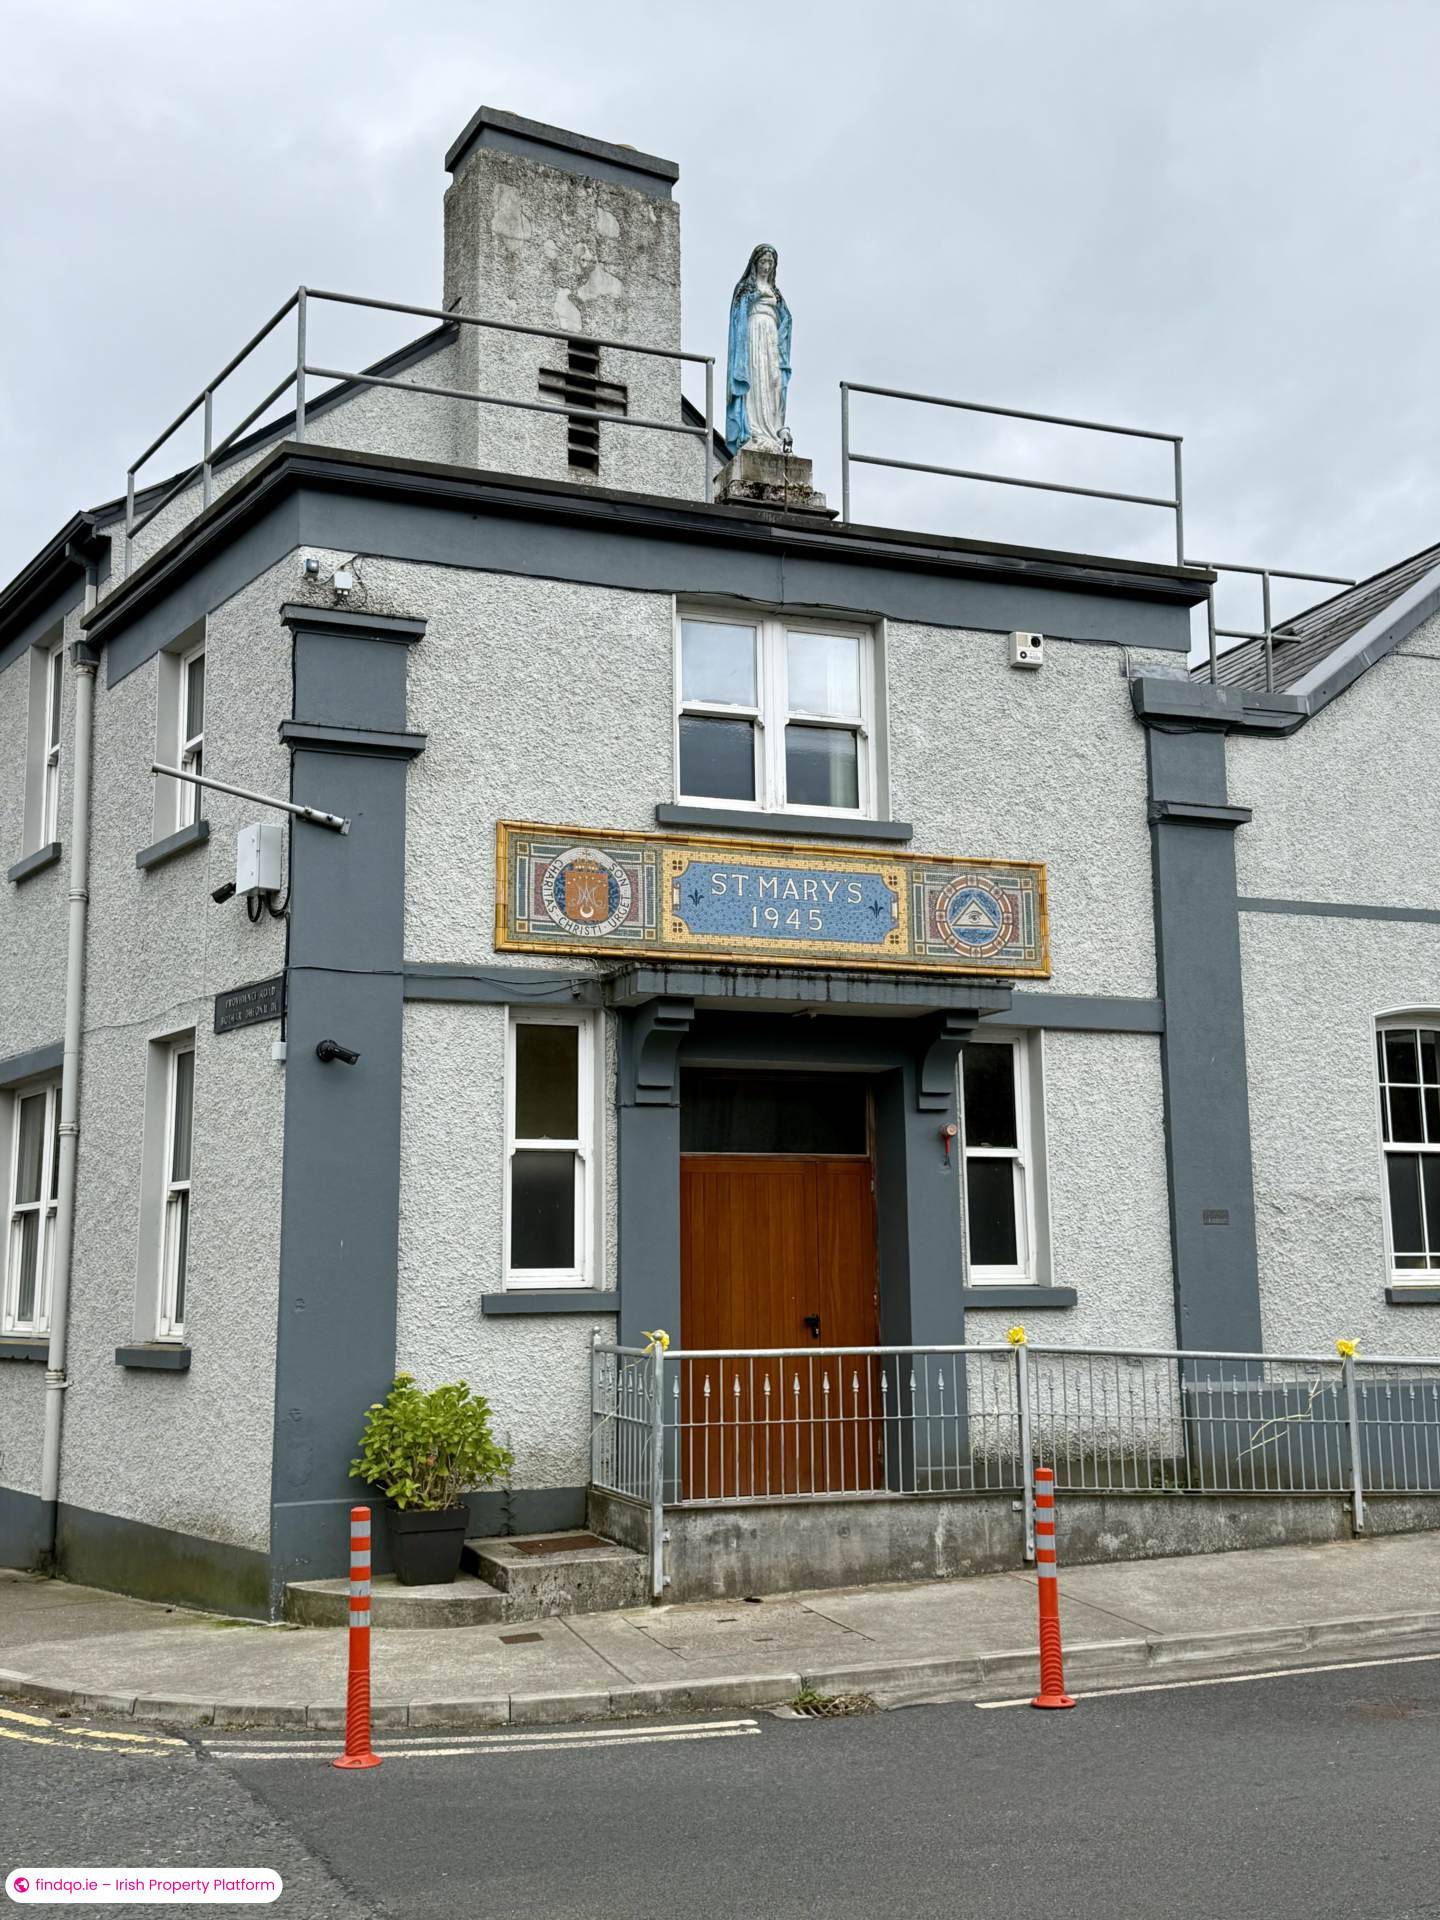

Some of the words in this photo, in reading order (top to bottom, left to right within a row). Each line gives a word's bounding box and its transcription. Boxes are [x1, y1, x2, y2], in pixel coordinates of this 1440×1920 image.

[543, 859, 564, 913] CHARITAS
[558, 916, 602, 936] CHRISTI
[608, 896, 631, 928] URGET
[758, 876, 863, 904] MARY'S
[751, 906, 824, 931] 1945
